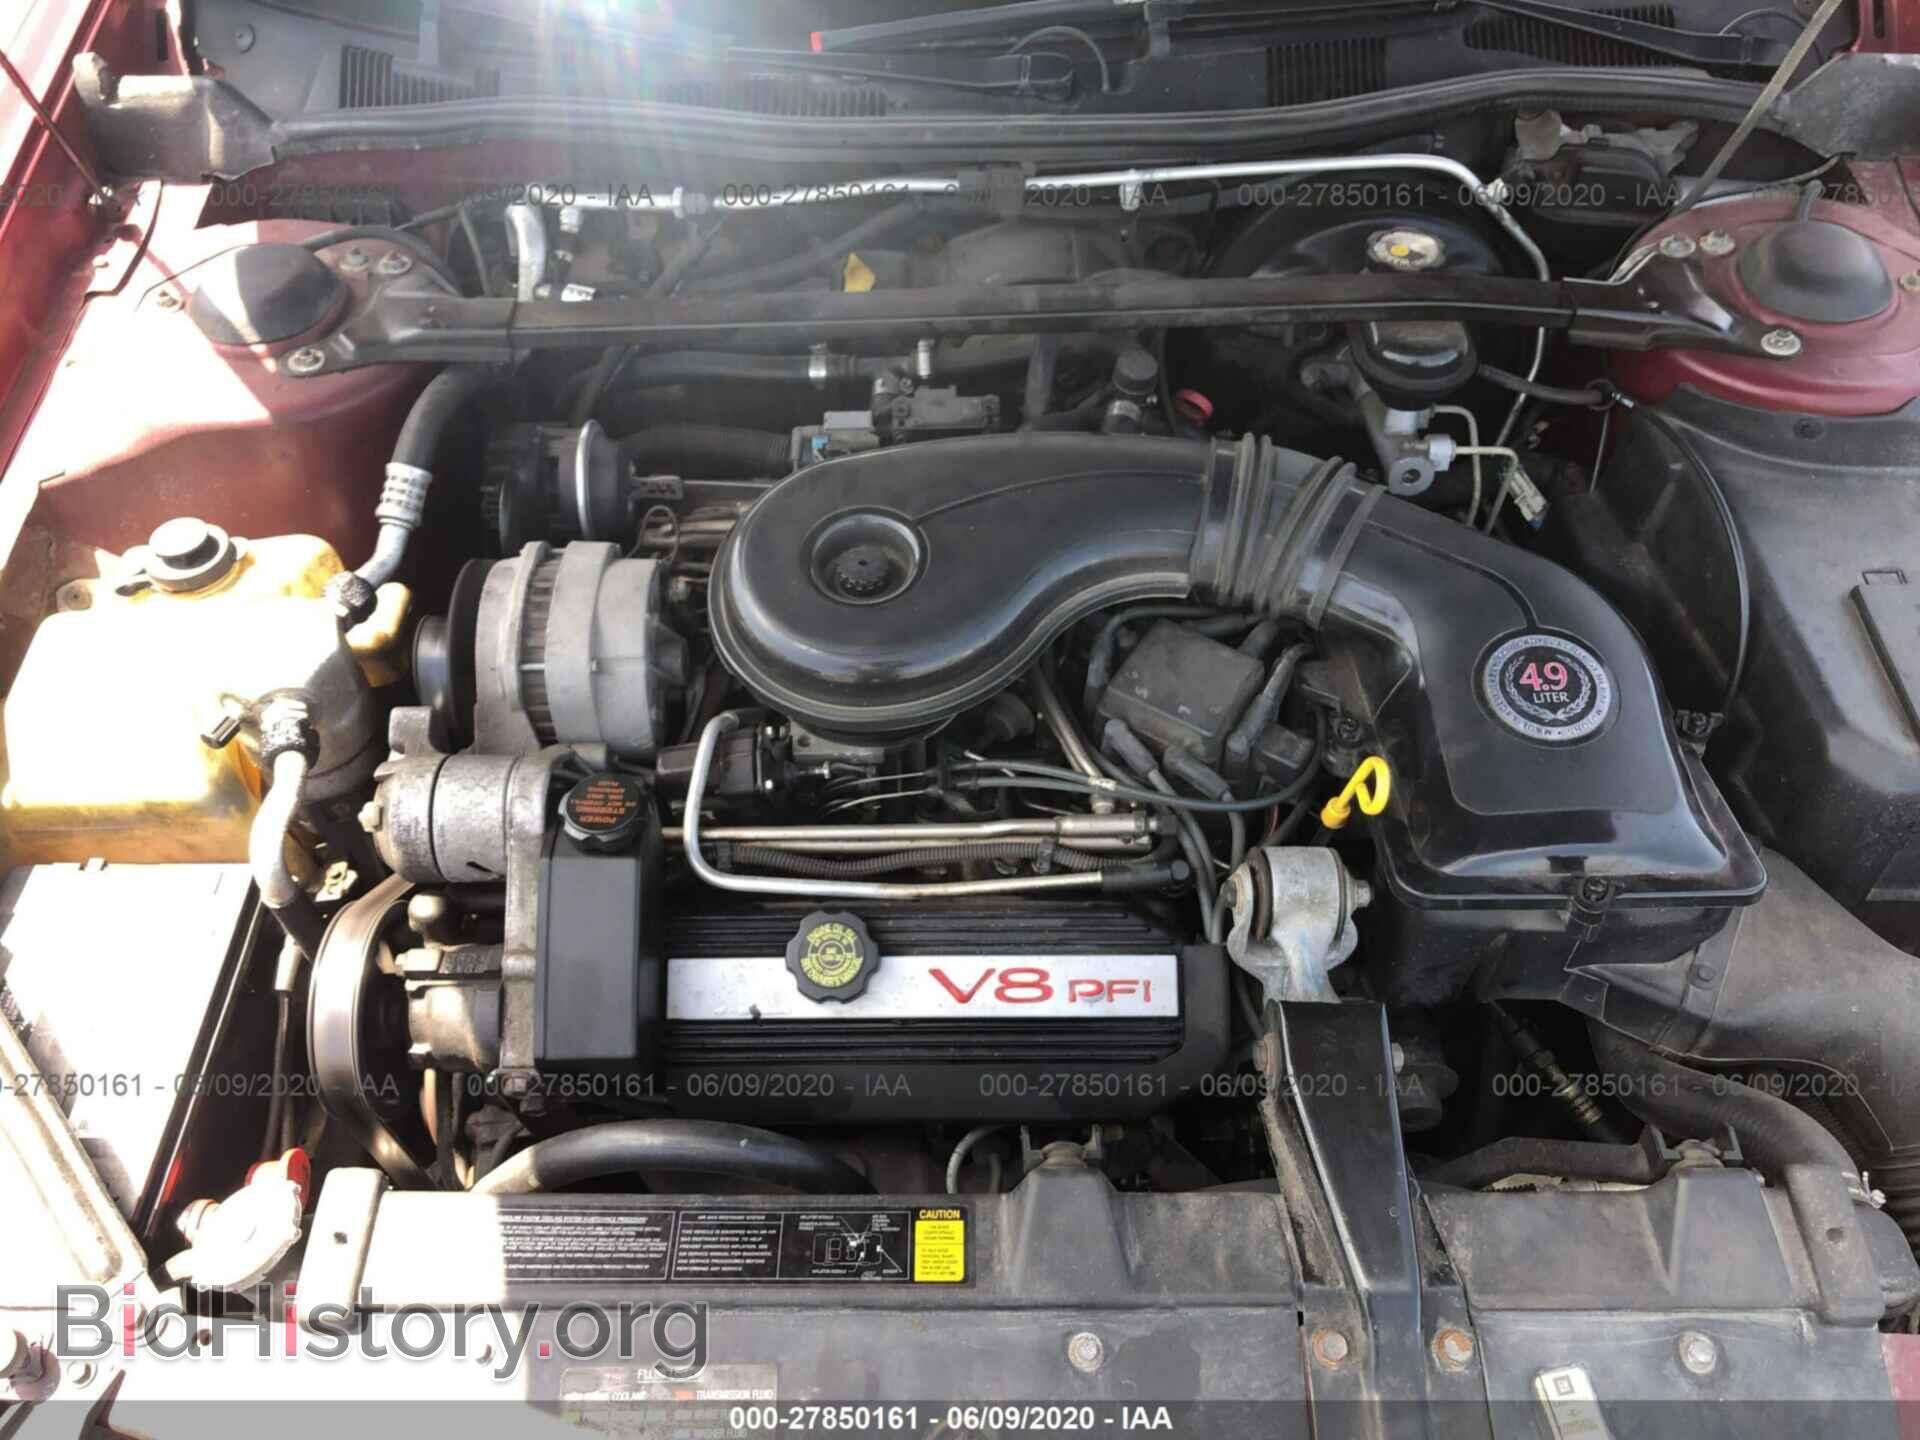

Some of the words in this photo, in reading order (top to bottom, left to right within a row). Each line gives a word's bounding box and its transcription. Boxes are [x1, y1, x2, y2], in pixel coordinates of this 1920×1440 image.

[1519, 661, 1568, 691] 4.9
[1533, 691, 1570, 704] LITER
[579, 815, 617, 825] POWER
[928, 967, 1054, 1005] V8
[1068, 978, 1152, 1004] PFI
[919, 1209, 961, 1219] CAUTION
